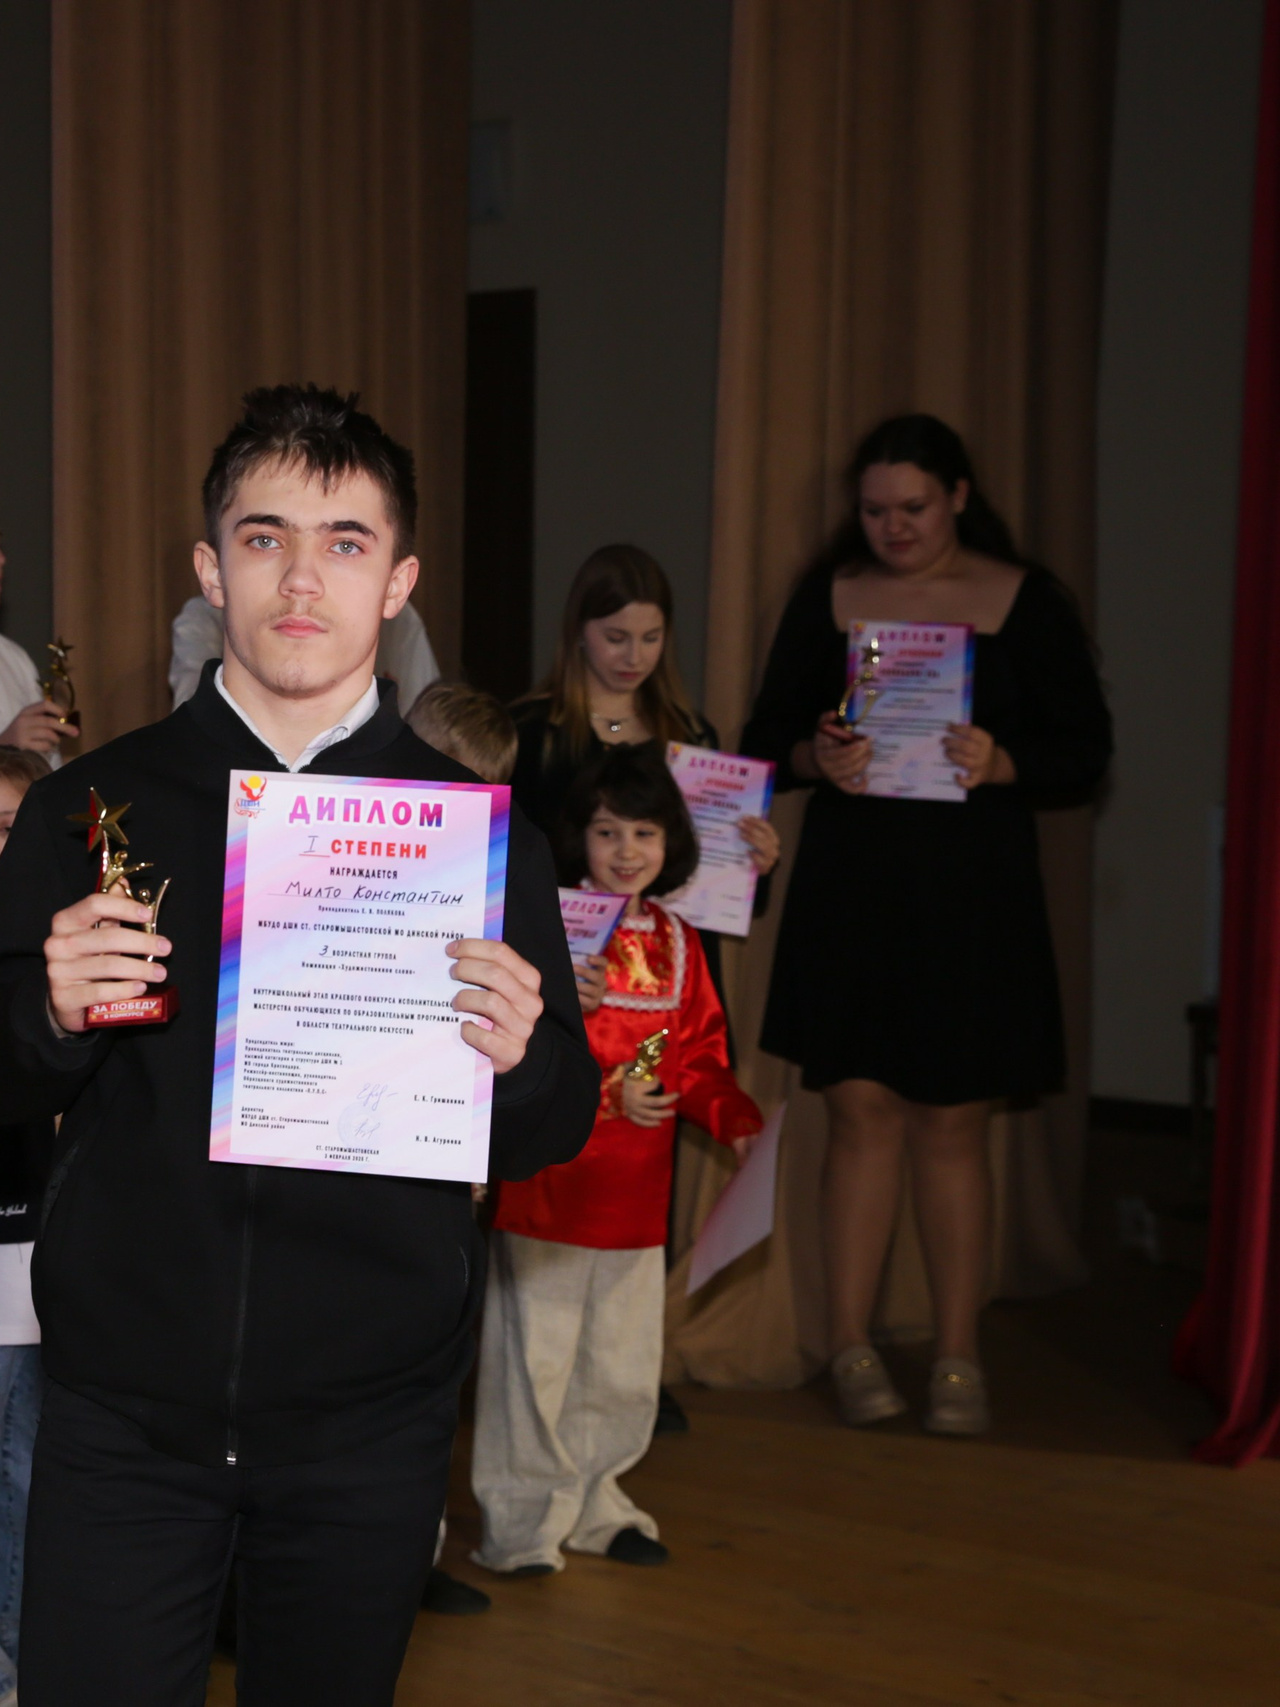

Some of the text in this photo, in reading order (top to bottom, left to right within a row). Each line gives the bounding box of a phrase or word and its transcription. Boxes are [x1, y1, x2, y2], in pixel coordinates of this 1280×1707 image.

[288, 796, 443, 828] ДИПЛОМ
[330, 838, 426, 859] СТЕПЕНИ
[329, 866, 397, 879] НАГРАЖДАЕТСЯ
[93, 1001, 157, 1013] ЗА ПОБЕДУ
[330, 993, 362, 1002] КРАЕВОГО
[364, 995, 395, 1004] КОНКУРСА
[398, 998, 453, 1008] ИСПОЛНИТЕЛЬСК
[253, 1002, 291, 1011] МАСТЕРСТВА
[293, 1005, 340, 1014] ОБУЧАЮЩИХСЯ
[353, 1009, 414, 1020] ОБРАЗОВАТЕЛЬНЫМ
[417, 1014, 459, 1023] ПРОГРАММАМ
[302, 1020, 329, 1029] ОБЛАСТИ
[331, 1022, 377, 1032] ТЕАТРАЛЬНОГО
[379, 1026, 413, 1034] ИСКУССТВА
